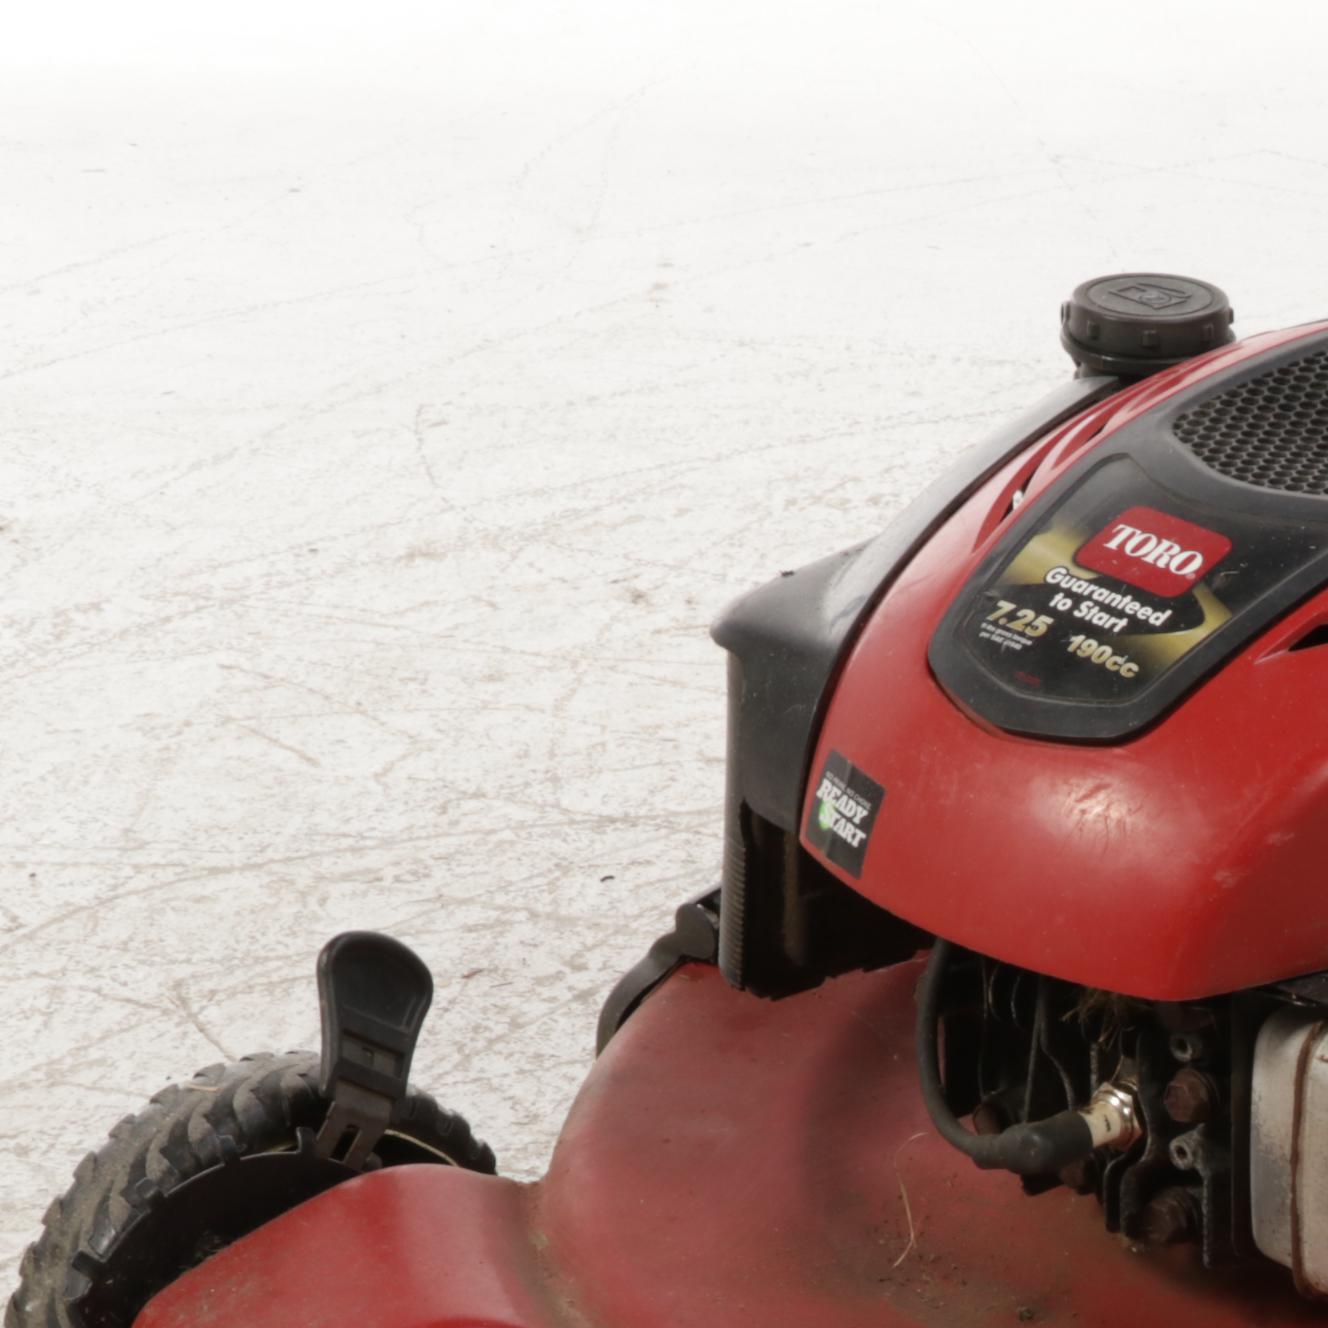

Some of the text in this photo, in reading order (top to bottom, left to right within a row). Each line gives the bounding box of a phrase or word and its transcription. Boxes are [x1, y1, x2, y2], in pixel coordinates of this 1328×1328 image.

[1103, 523, 1204, 576] TORO
[985, 599, 1055, 637] 7.25
[1045, 566, 1173, 627] Guaranteed
[1049, 593, 1130, 633] to Start
[1066, 633, 1140, 679] 190cc
[815, 777, 870, 825] READY
[818, 803, 867, 848] START
